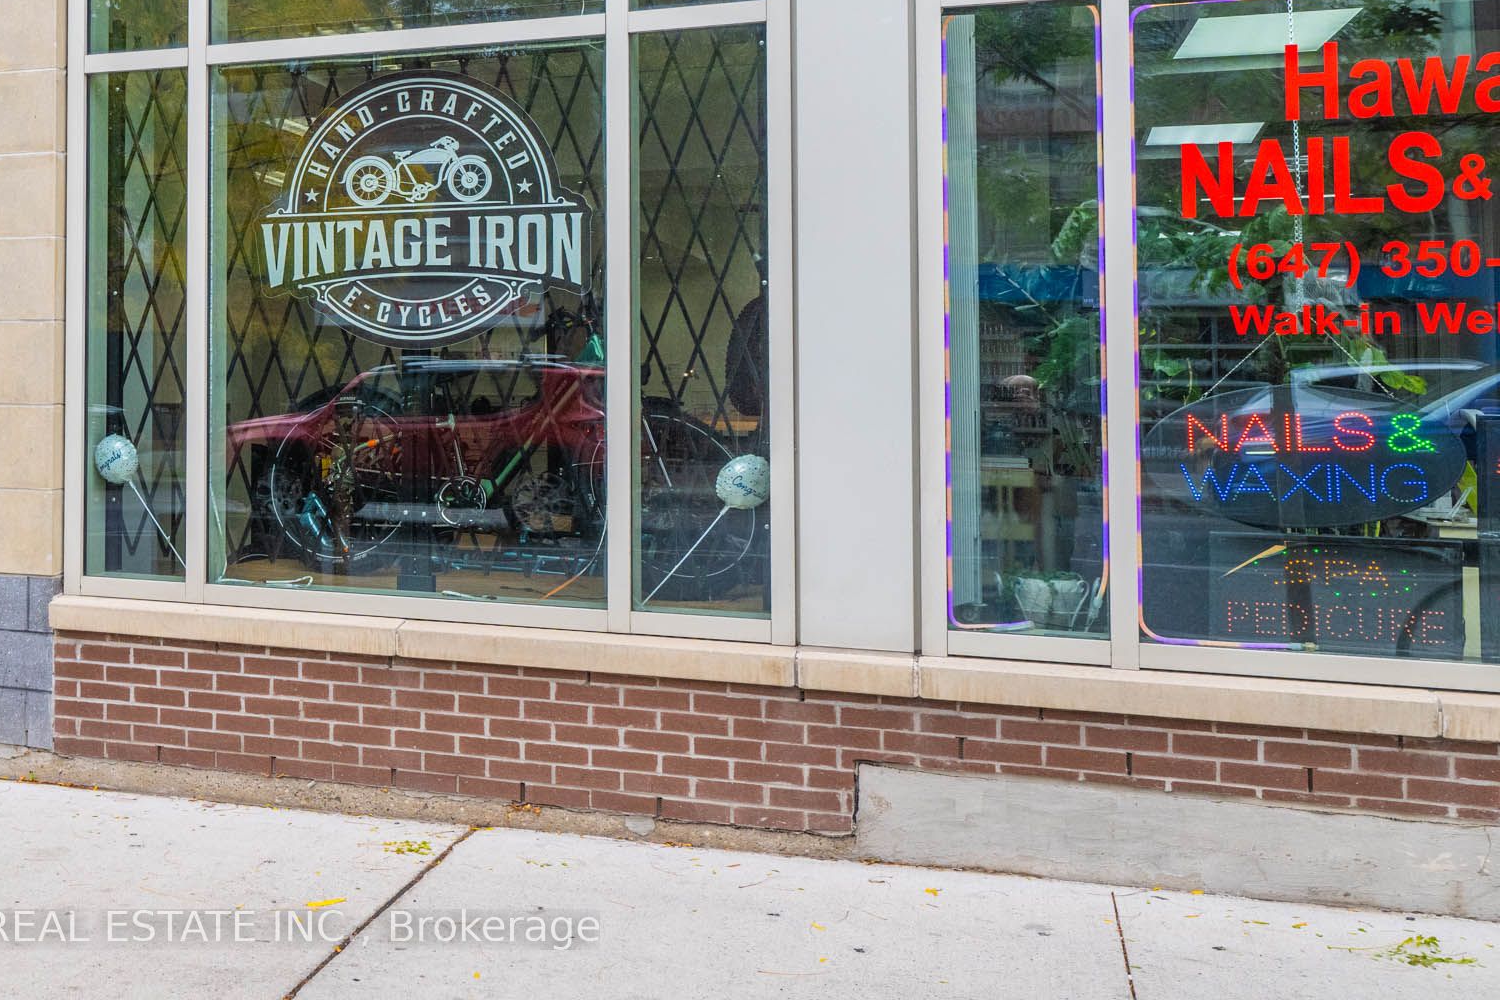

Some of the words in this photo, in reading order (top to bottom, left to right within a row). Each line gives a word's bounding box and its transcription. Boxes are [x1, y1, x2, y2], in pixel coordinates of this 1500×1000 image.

[308, 89, 530, 179] HAND-CRAFTED
[1181, 131, 1444, 218] NAILS
[1453, 154, 1493, 200] &
[261, 216, 451, 289] VINTAGE
[468, 212, 583, 285] IRON
[1228, 241, 1360, 290] (647)
[342, 284, 492, 327] E-CYCLES
[1228, 302, 1401, 336] Walk-in
[1188, 412, 1375, 452] NAILS
[1388, 413, 1435, 452] &
[1180, 463, 1428, 503] WAXING
[1274, 559, 1389, 588] SPA
[1228, 601, 1445, 644] PEDICURE
